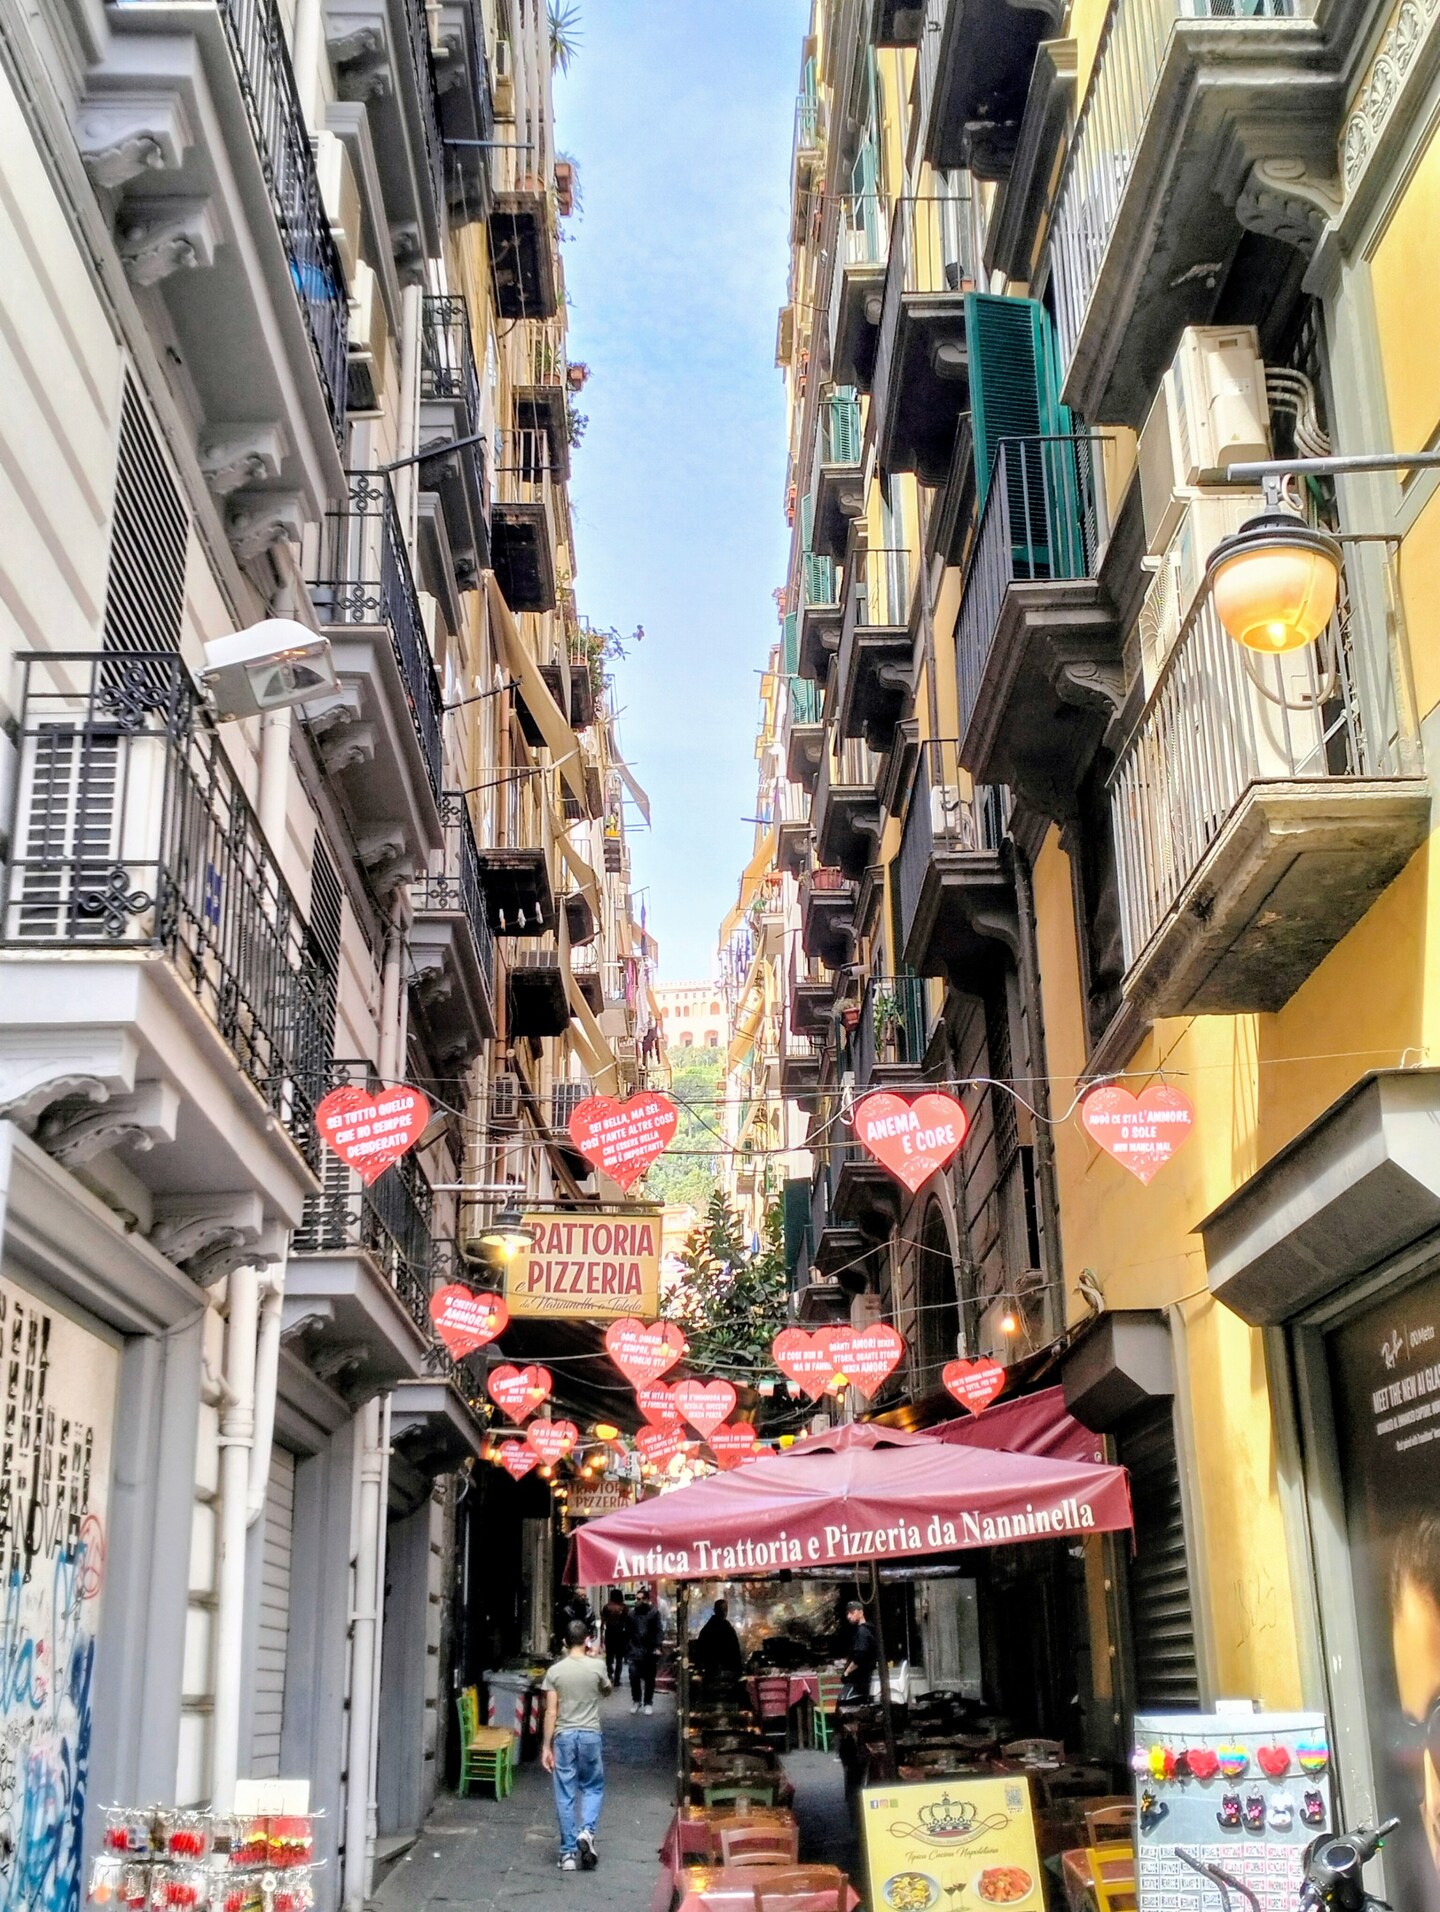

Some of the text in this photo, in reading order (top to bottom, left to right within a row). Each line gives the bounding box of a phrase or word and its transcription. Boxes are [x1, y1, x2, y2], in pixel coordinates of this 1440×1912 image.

[326, 1097, 414, 1129] SEI TUTTO QUELLO
[589, 1121, 602, 1134] SEI
[603, 1114, 630, 1130] BELLA,
[631, 1108, 644, 1121] MA
[1122, 1114, 1137, 1125] STA
[1139, 1109, 1192, 1124] L'AMMORE,
[336, 1114, 412, 1144] CHE HO SEMPRE
[581, 1112, 674, 1151] COSÌ TANTE ALTRE COSE
[866, 1111, 921, 1142] ANEMA
[902, 1123, 956, 1155] E CORE
[1132, 1126, 1157, 1138] SOLE
[347, 1132, 408, 1158] DESIDERATO
[602, 1130, 659, 1156] CHE ESSERE BELLA
[622, 1140, 665, 1161] IMPORTANTE
[514, 1260, 643, 1295] e PIZZERIA
[608, 1297, 642, 1313] Toledo
[852, 1338, 876, 1350] AMORI
[861, 1361, 891, 1373] AMORE.
[575, 1496, 629, 1508] PIZZERIA
[612, 1498, 1095, 1578] Antica Trattoria e Pizzeria da Nanninella
